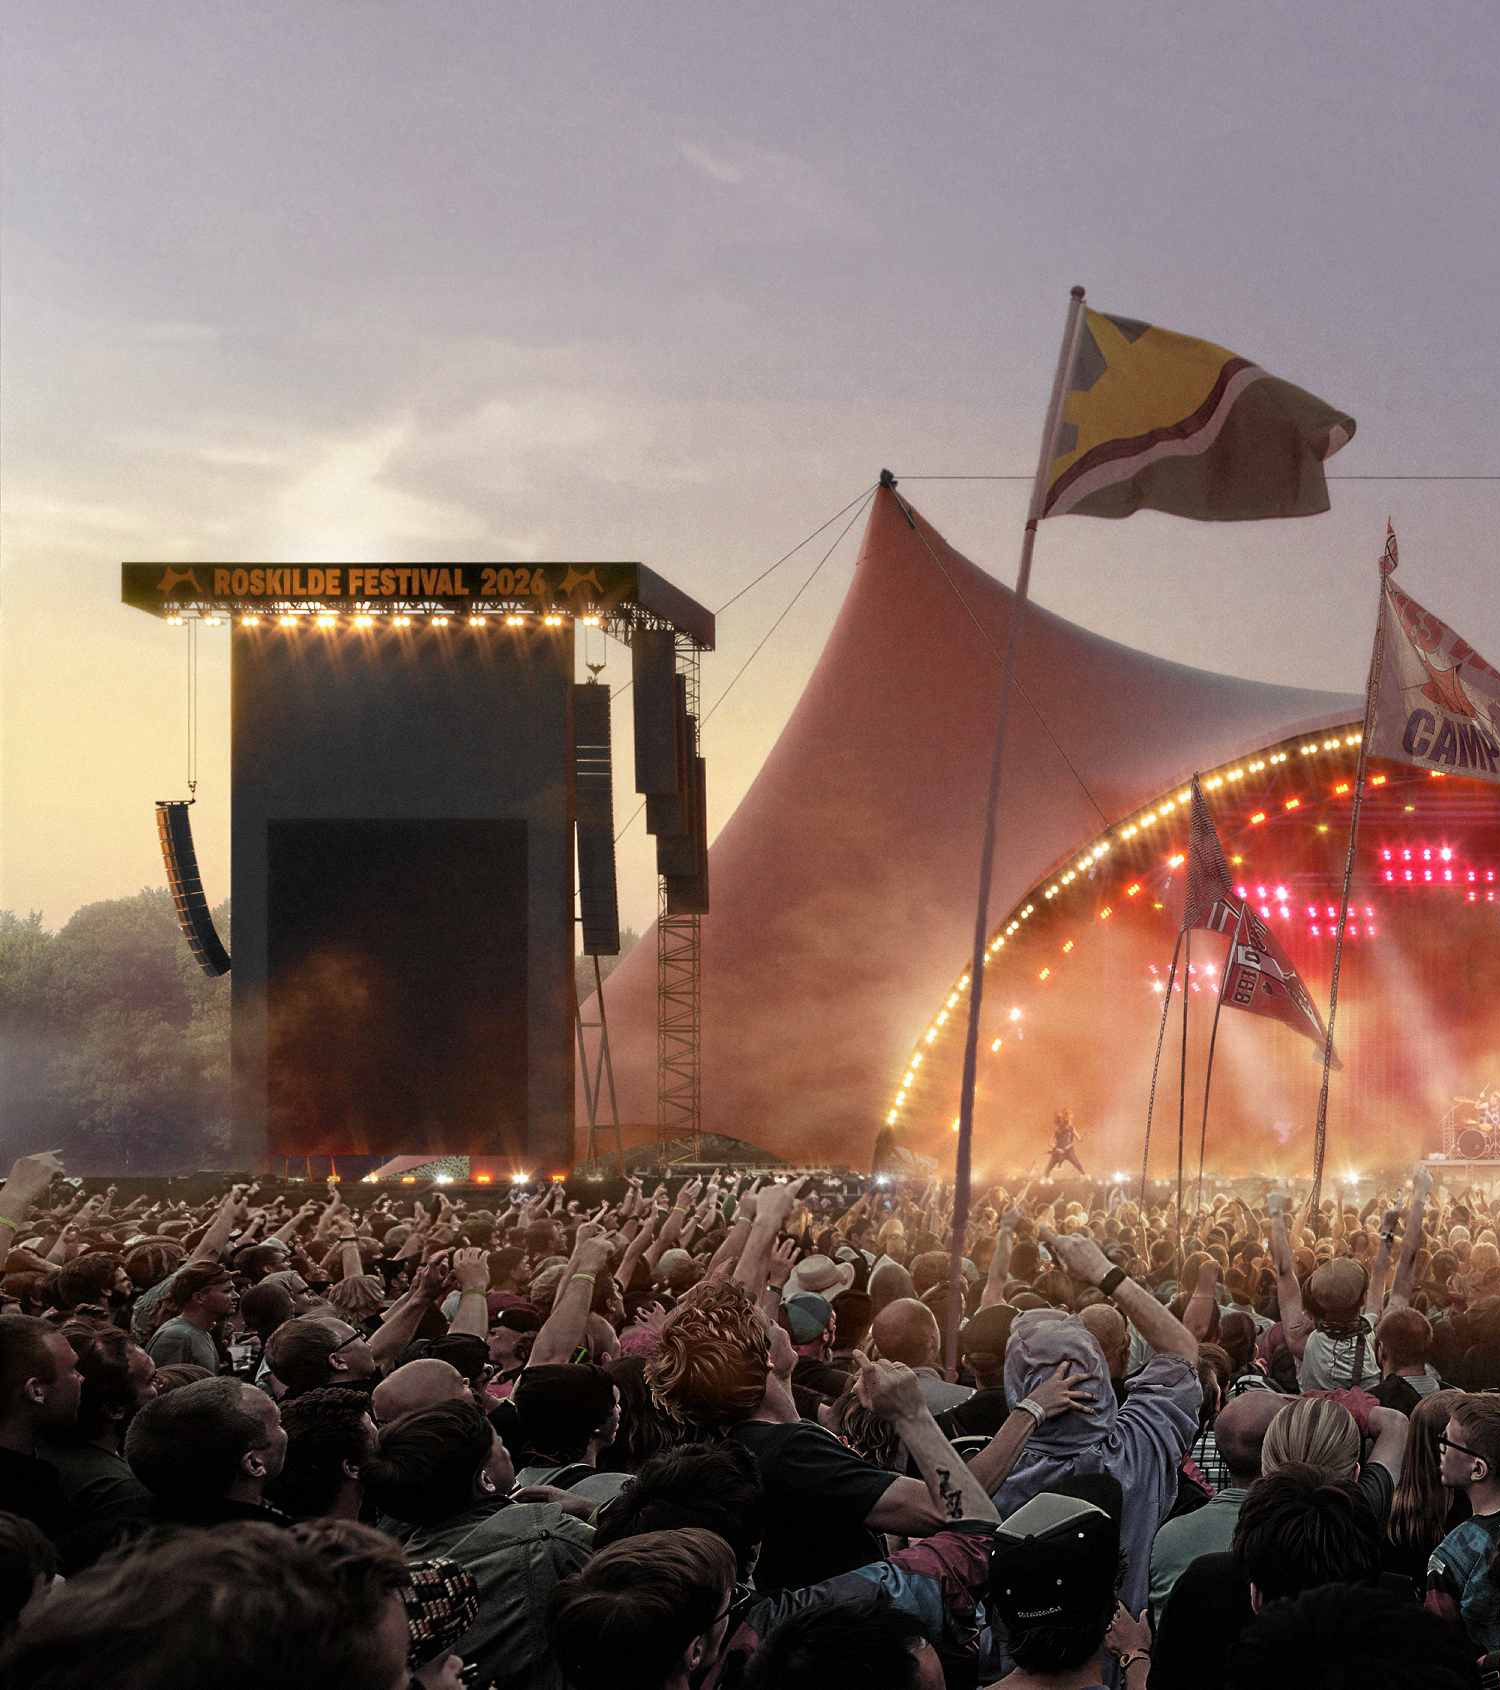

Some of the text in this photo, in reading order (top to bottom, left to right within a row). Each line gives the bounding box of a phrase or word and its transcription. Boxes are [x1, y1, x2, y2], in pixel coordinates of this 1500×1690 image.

[214, 567, 546, 596] ROSKILDE FESTIVAL 2026
[1403, 708, 1500, 773] CAMP
